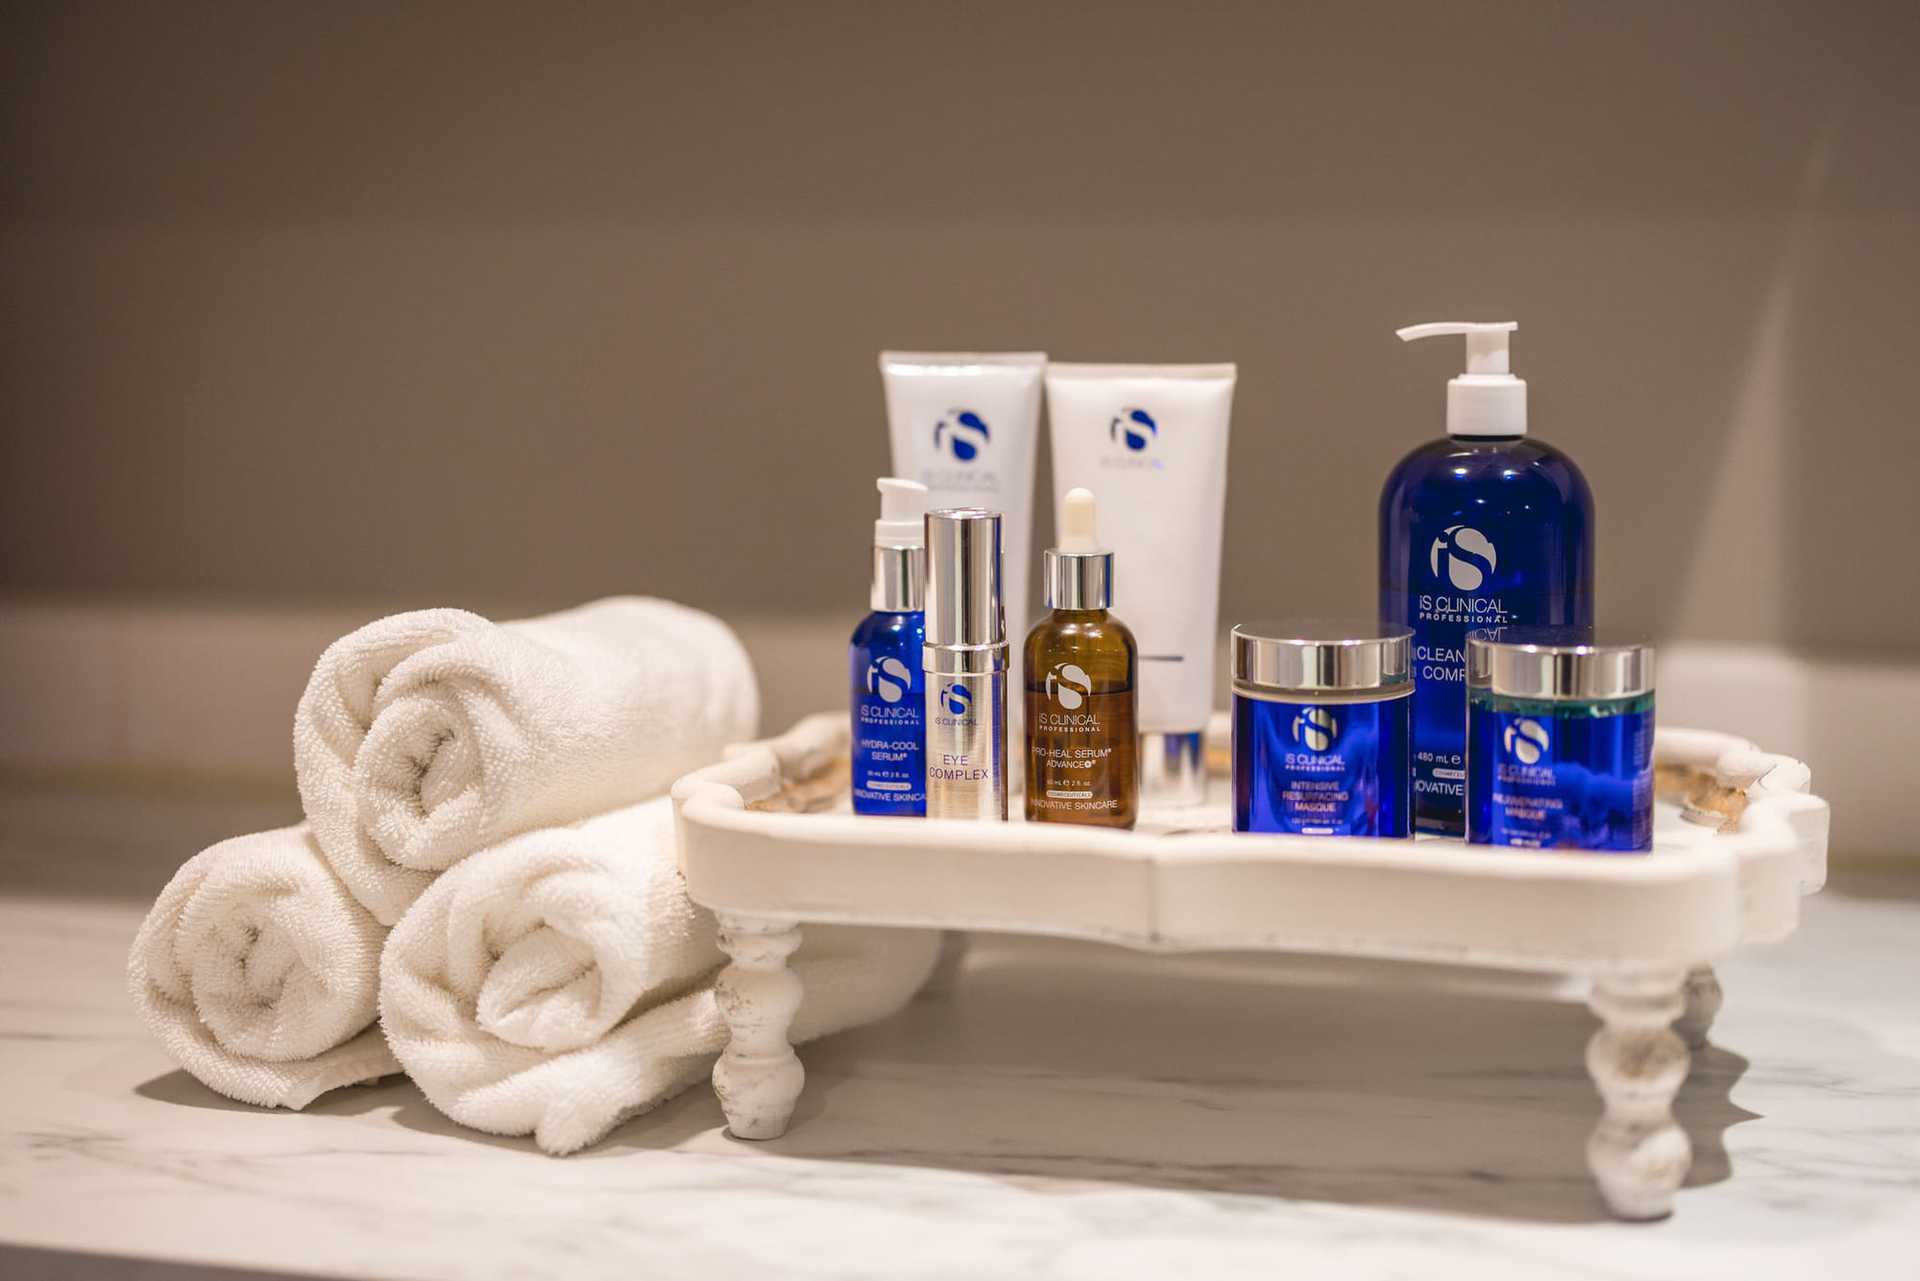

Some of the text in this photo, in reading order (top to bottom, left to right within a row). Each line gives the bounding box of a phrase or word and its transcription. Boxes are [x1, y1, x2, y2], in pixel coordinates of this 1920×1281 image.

[1435, 596, 1508, 614] CLINICAL
[1419, 612, 1508, 623] PROFESSIONAL
[1416, 646, 1466, 663] CLEAN
[1422, 665, 1465, 682] COMP
[870, 706, 920, 719] CLINICAL
[1049, 713, 1101, 726] CLINICAL
[1039, 725, 1101, 733] PROFESSIONAL
[861, 738, 920, 751] HYDRA-COOL
[1031, 746, 1072, 759] PRO-HEAL
[1417, 752, 1433, 762] 480
[943, 754, 969, 766] EYE
[929, 765, 989, 781] COMPLEX
[1074, 799, 1118, 811] SKINCARE
[1294, 802, 1336, 813] MASQUE
